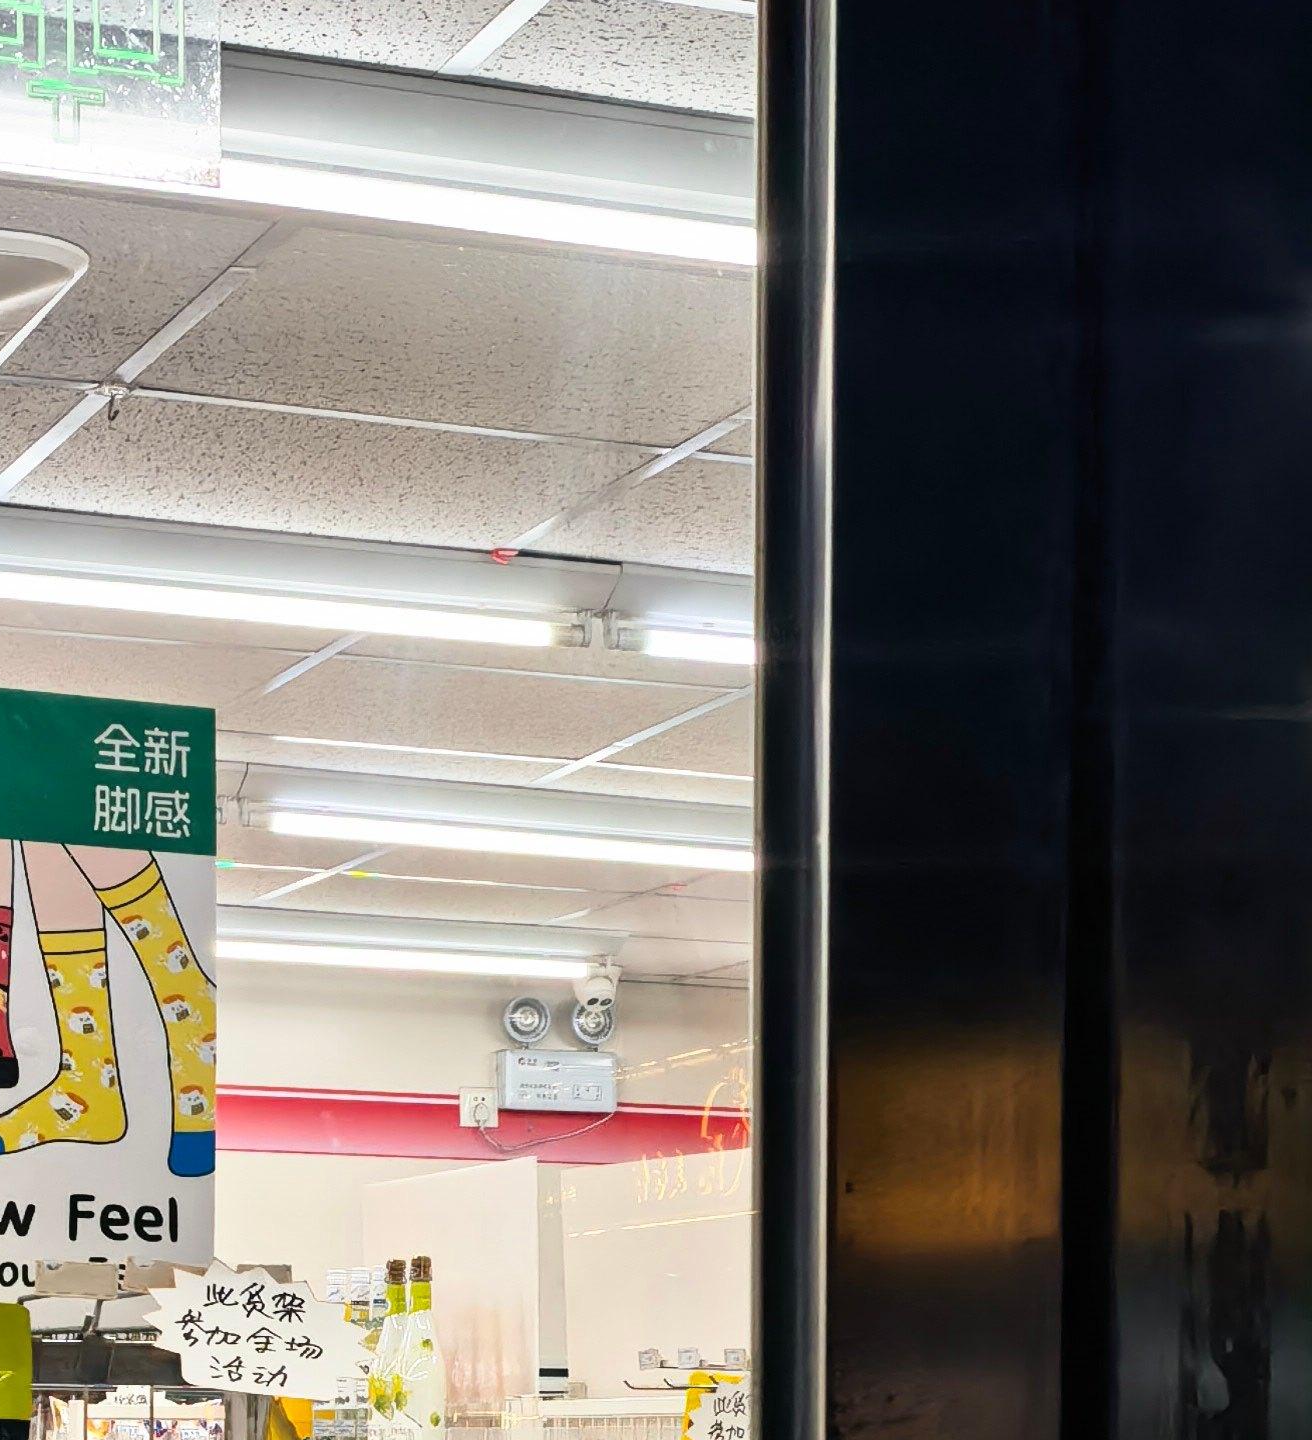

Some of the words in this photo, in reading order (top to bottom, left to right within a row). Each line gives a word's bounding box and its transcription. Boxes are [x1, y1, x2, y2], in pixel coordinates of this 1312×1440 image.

[94, 723, 191, 779] 全新
[94, 785, 192, 841] 脚感
[67, 1190, 181, 1246] Feel
[204, 1282, 308, 1323] 此货架
[175, 1310, 325, 1360] 参加全场
[209, 1356, 288, 1388] 活动
